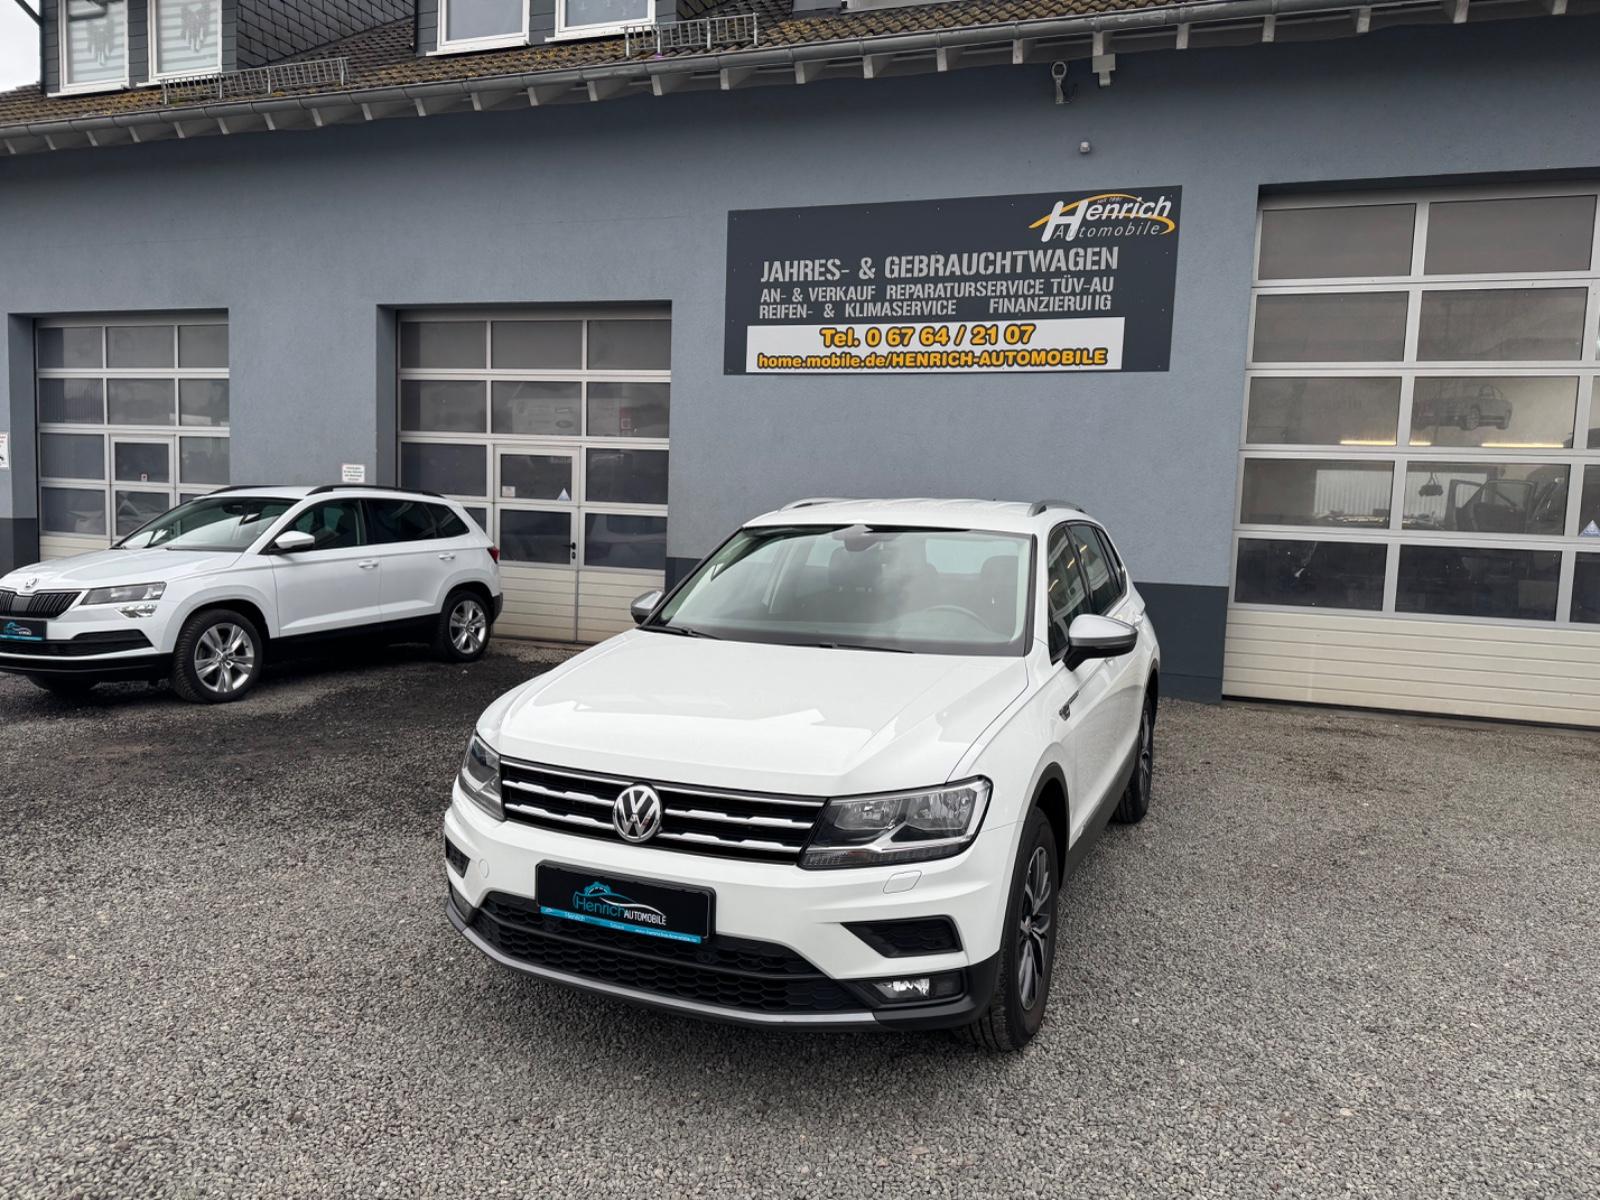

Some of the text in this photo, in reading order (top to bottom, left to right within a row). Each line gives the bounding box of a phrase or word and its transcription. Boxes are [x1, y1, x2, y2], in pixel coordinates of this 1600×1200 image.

[1041, 196, 1172, 242] Henrich
[760, 246, 1119, 282] JAHRES- & GEBRAUCHTWAGEN
[760, 274, 1115, 303] AN- & VERKAUF REPARATURSERVICE TÜV-AU
[759, 303, 814, 319] REIFEN-
[823, 302, 836, 318] &
[845, 300, 957, 318] KLIMASERVICE
[820, 323, 1037, 348] Tel. 0 67 64 / 21 07
[757, 347, 1109, 369] home.mobile.de/HENRICH-AUTOMOBILE
[576, 895, 626, 917] Henrich
[624, 909, 666, 926] AUTOMOBILE
